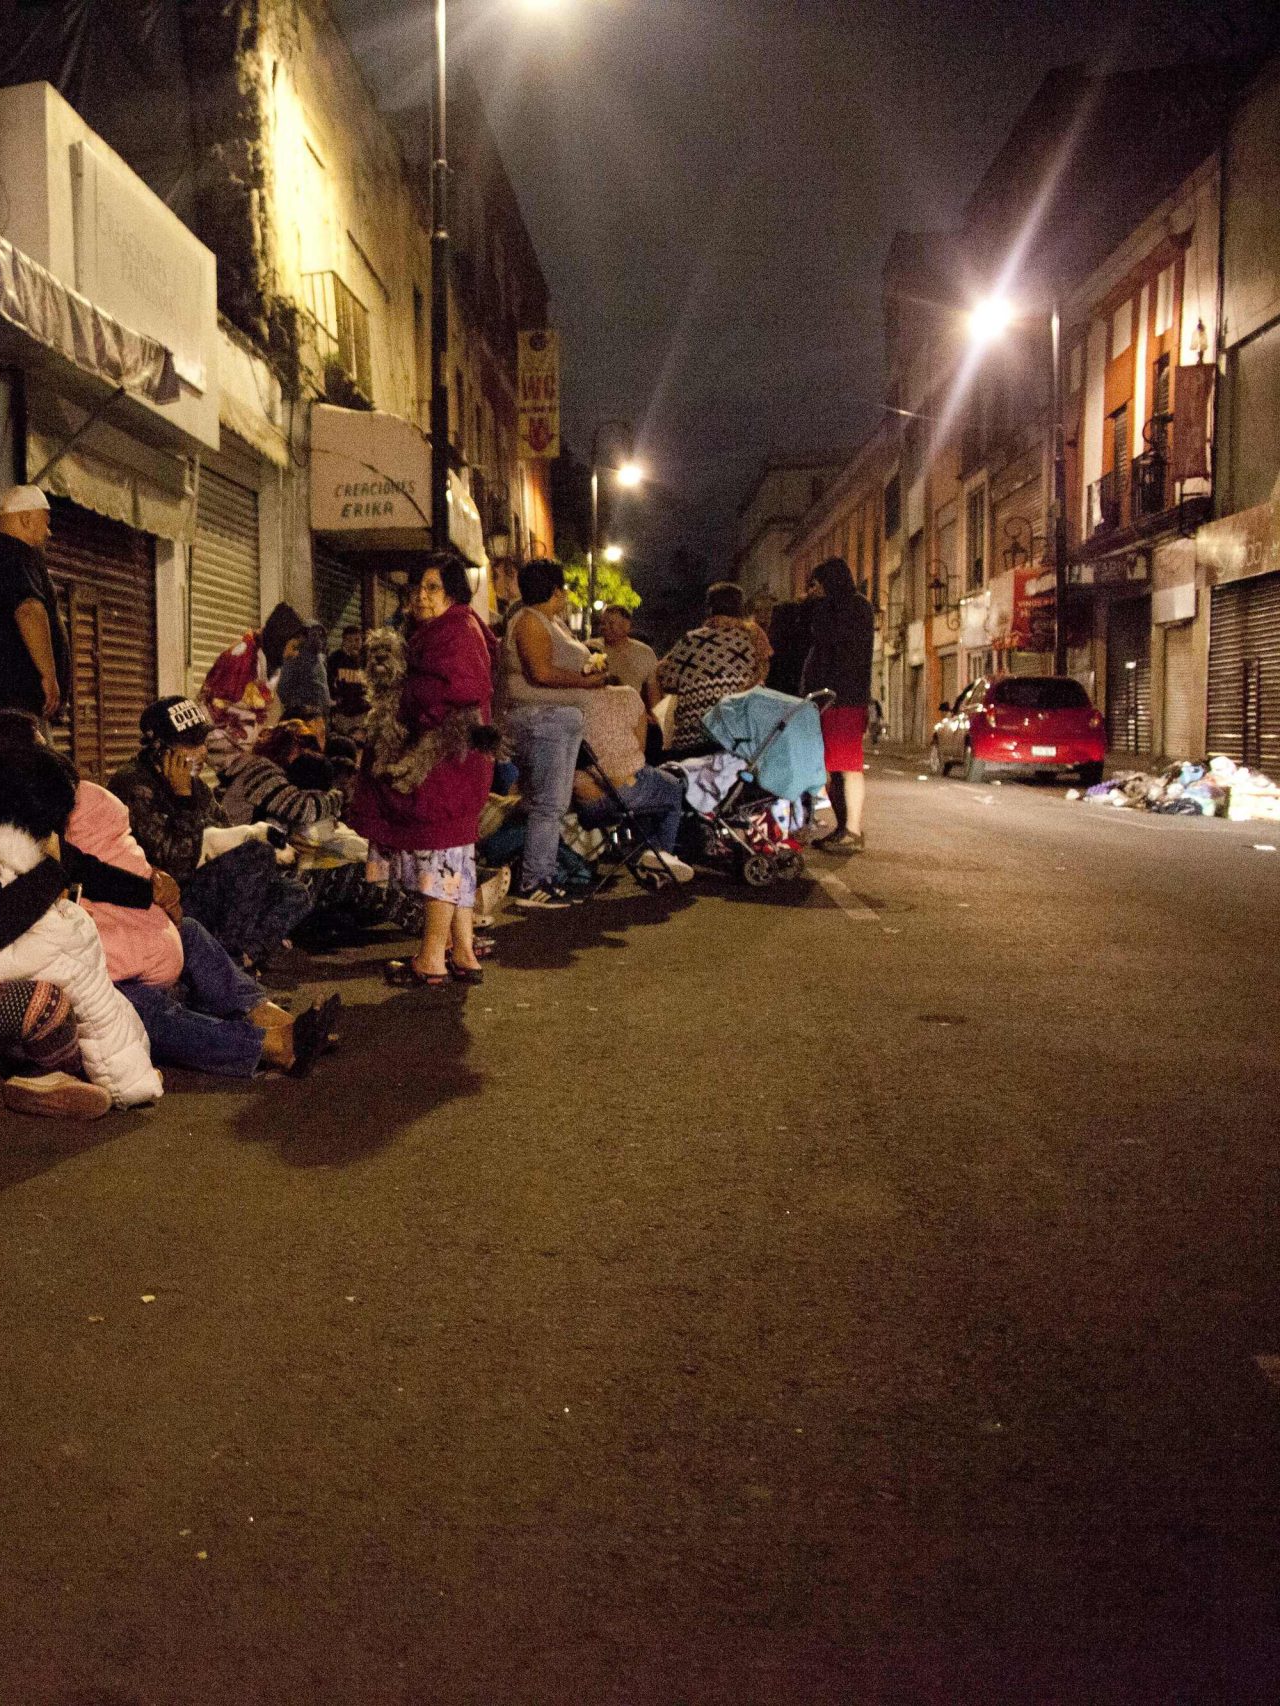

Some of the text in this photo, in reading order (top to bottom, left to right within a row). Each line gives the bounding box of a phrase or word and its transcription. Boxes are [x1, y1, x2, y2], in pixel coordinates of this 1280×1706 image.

[334, 481, 415, 498] CREACIONES
[341, 501, 394, 518] ERIKA
[174, 707, 199, 724] OUT
